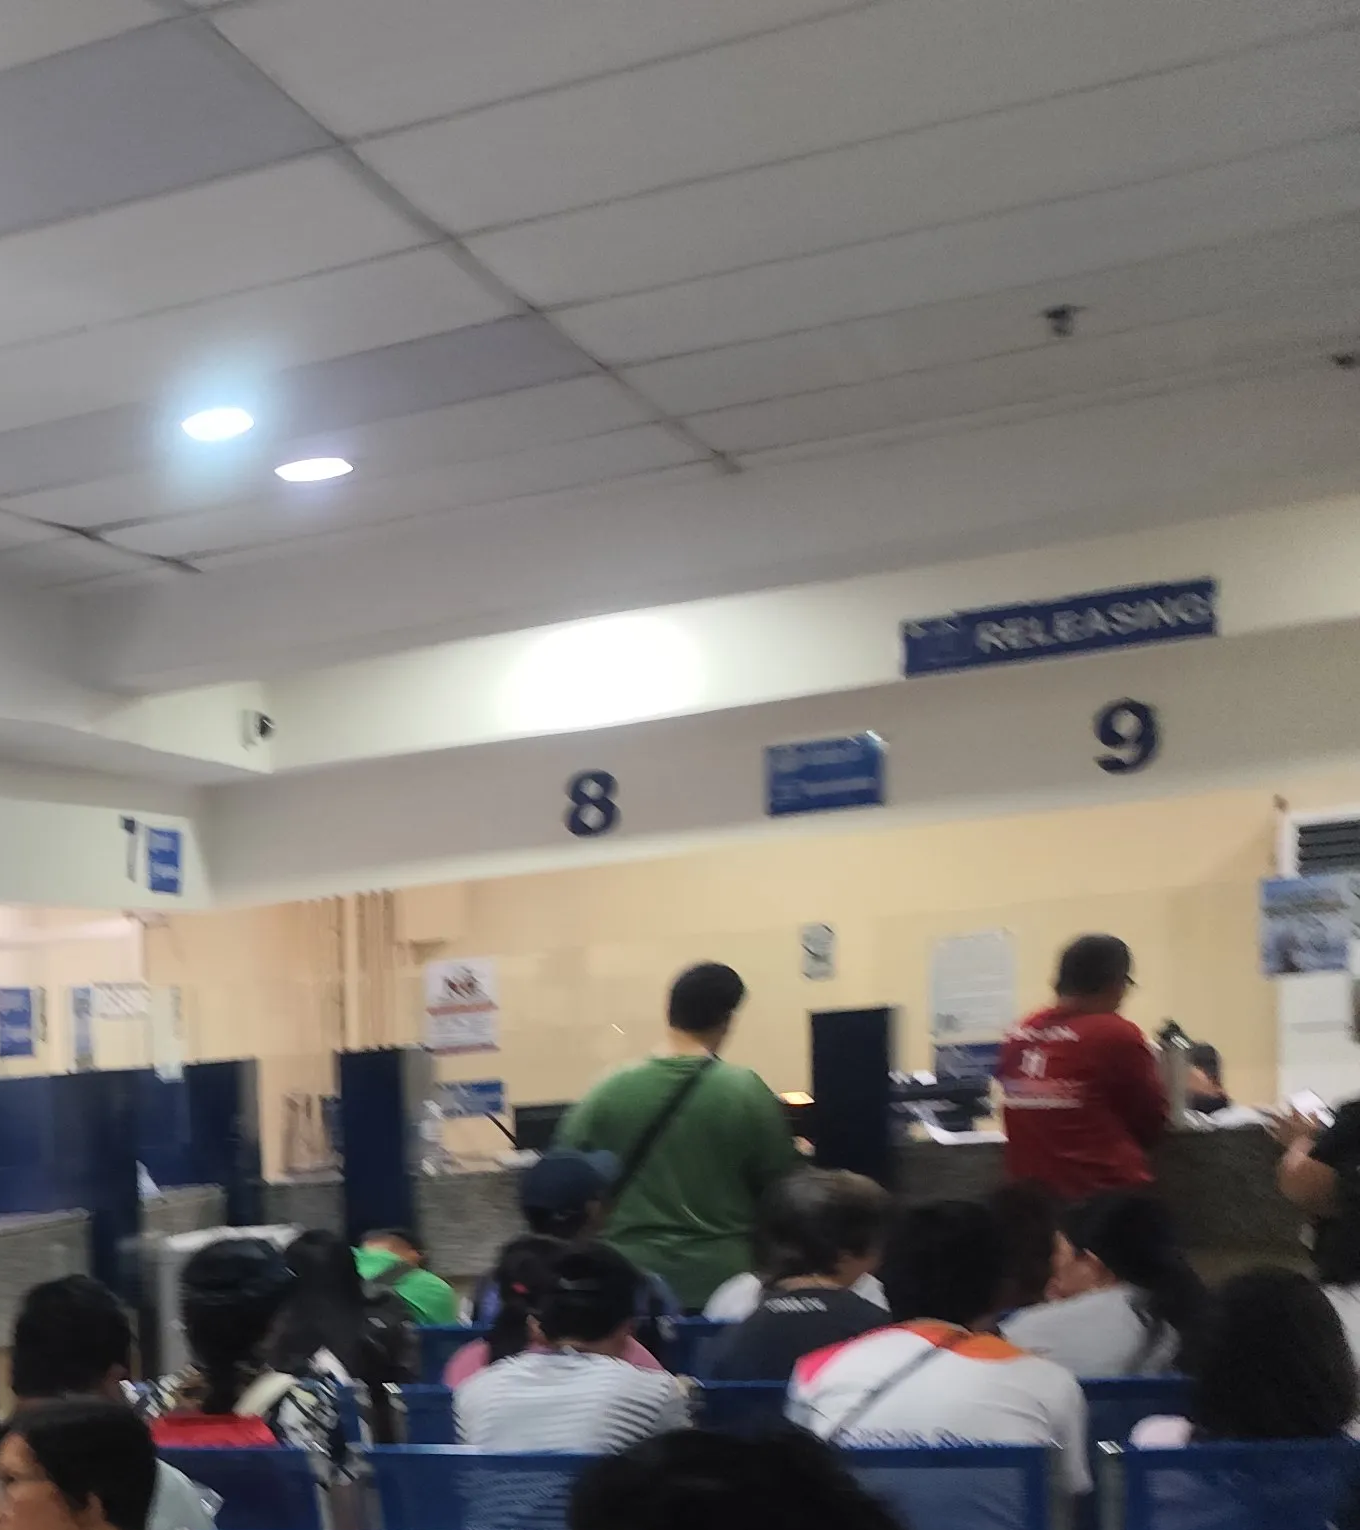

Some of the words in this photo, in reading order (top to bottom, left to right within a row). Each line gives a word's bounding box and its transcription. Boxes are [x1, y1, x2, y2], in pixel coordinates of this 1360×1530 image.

[973, 592, 1214, 653] RELEASING
[1092, 696, 1160, 774] 9
[564, 769, 621, 838] 8
